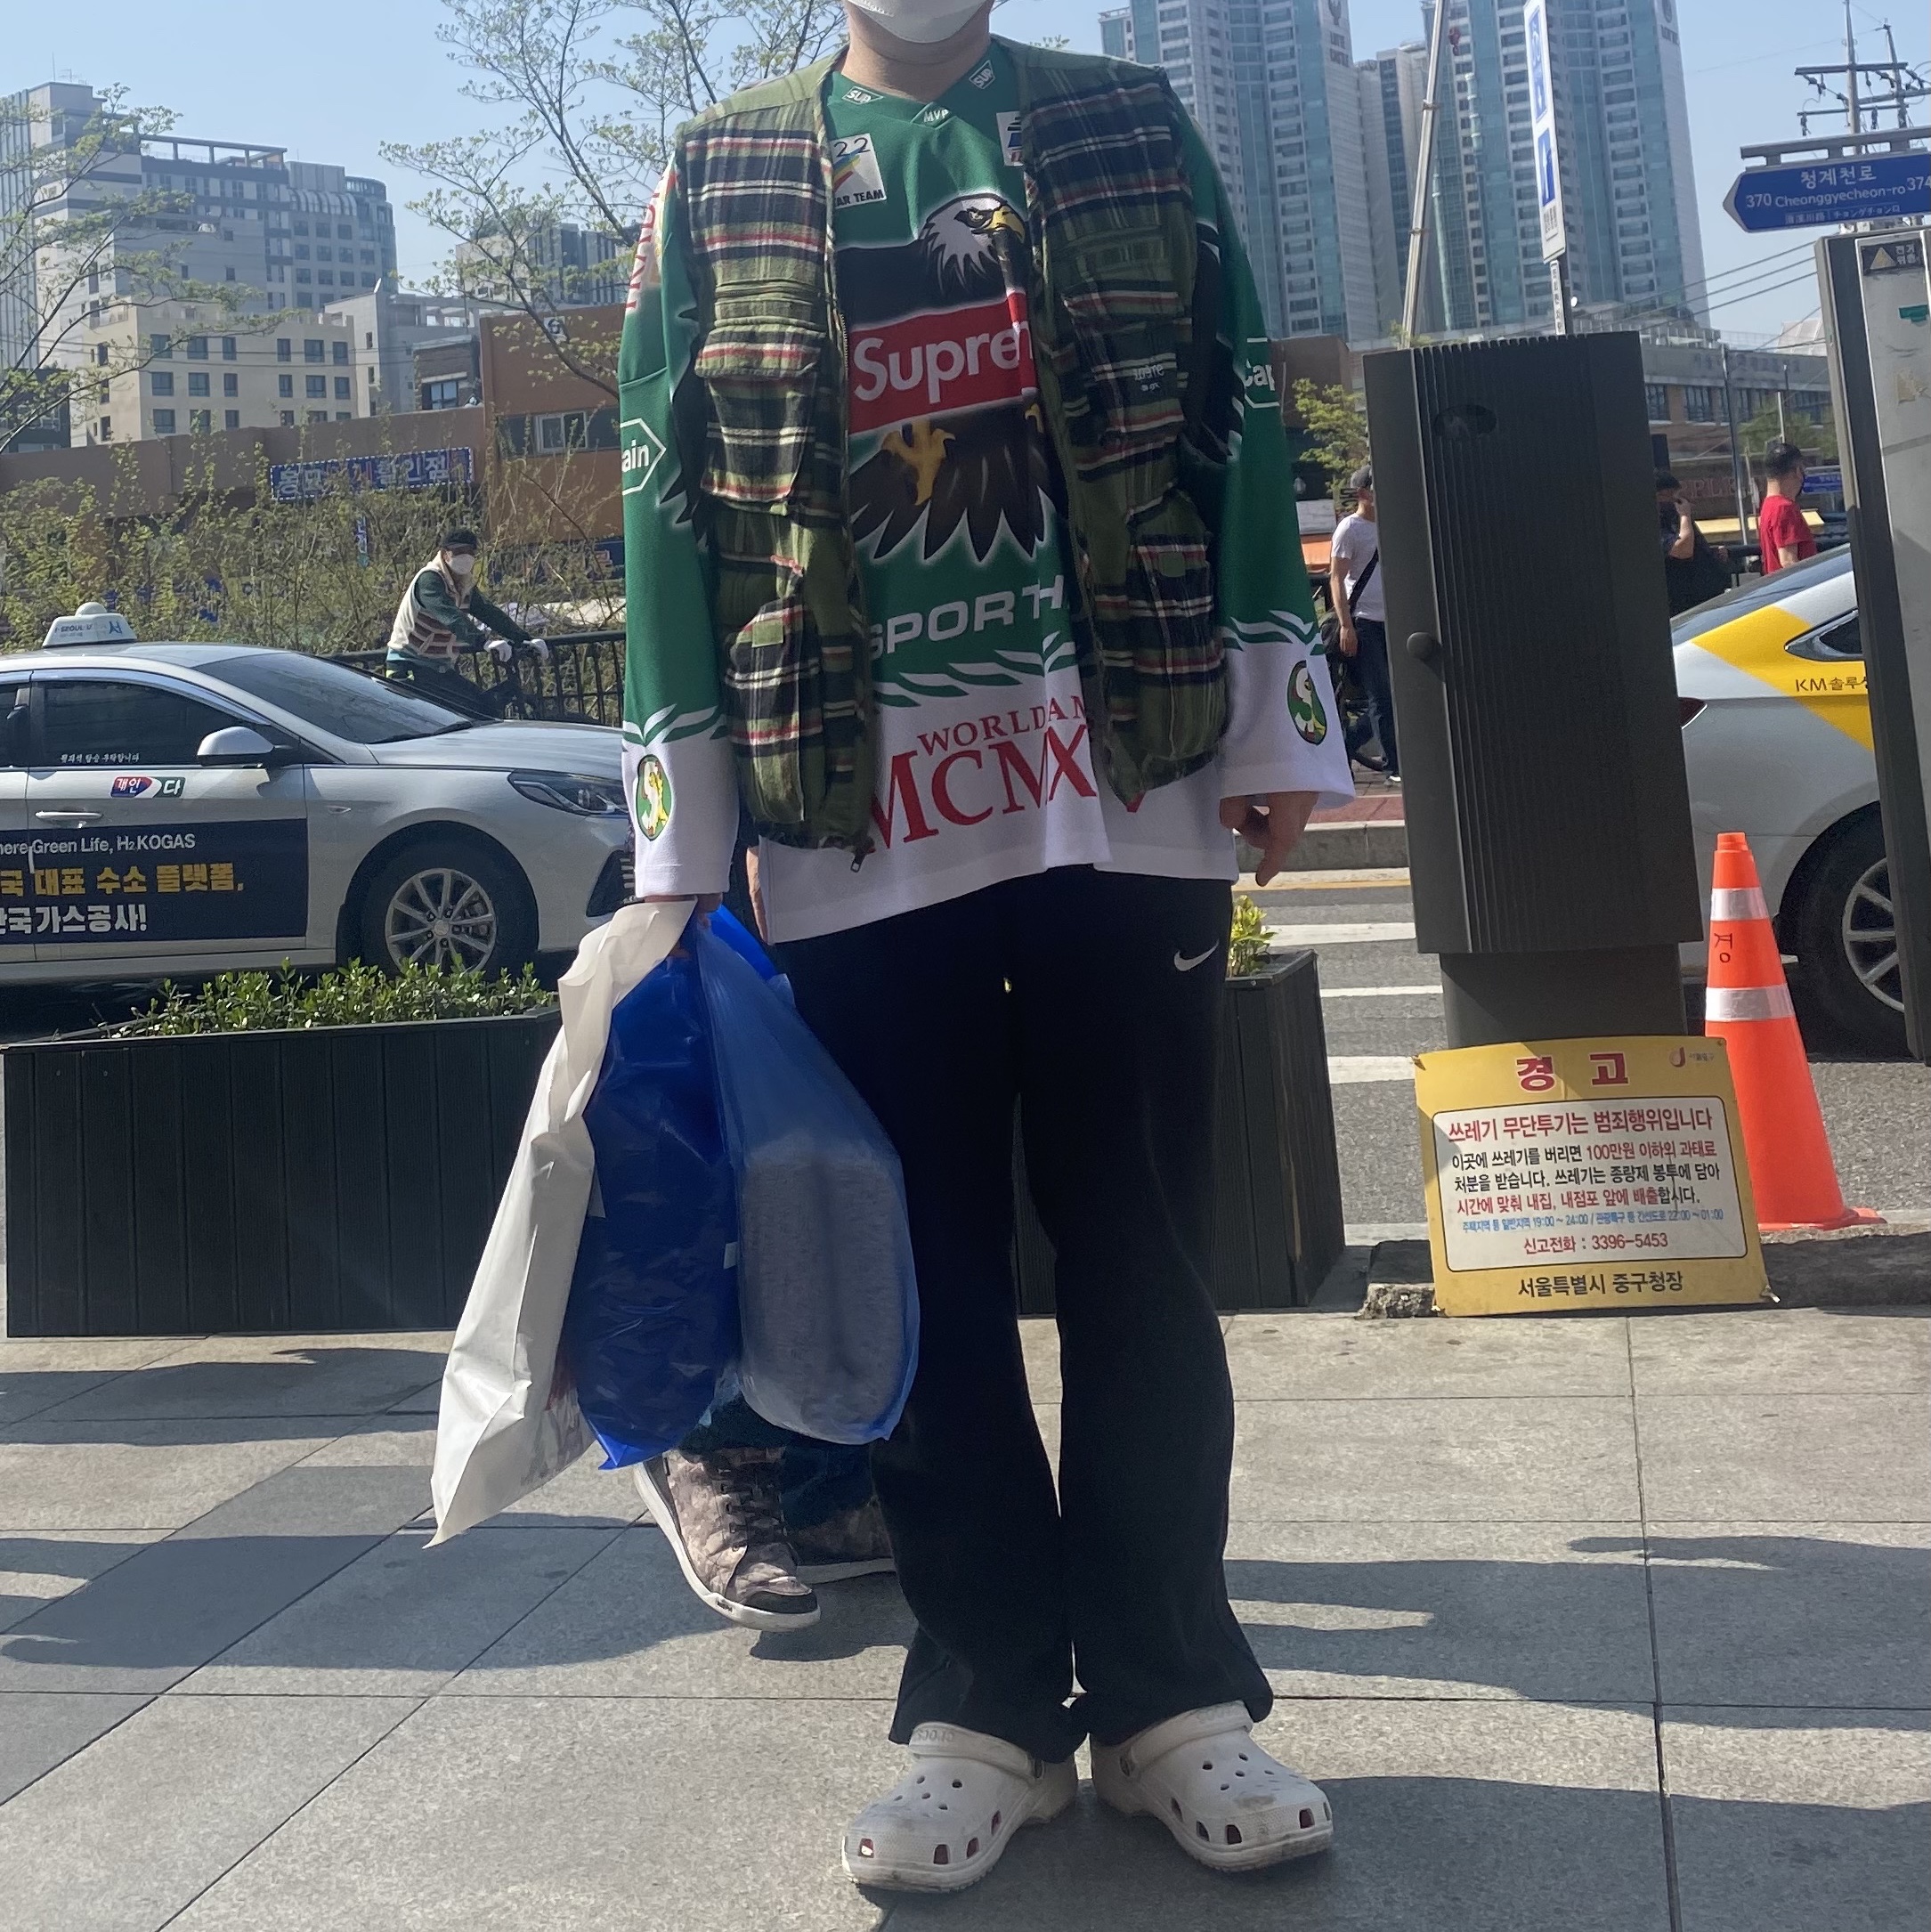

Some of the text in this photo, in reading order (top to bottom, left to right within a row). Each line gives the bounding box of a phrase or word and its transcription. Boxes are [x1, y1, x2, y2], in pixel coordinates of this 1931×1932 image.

[923, 108, 950, 123] MVP
[1800, 165, 1877, 190] 청계천로
[853, 189, 884, 202] TEAM
[1745, 193, 1773, 208] 370
[1774, 185, 1906, 208] Cheonggyecheon-ro
[117, 778, 142, 794] 개인
[163, 780, 181, 795] 다
[32, 839, 77, 854] Green
[81, 838, 114, 855] Life,
[35, 867, 86, 896] 대표
[97, 866, 147, 895] 수소
[156, 862, 244, 892] 플랫폼,
[1448, 1108, 1712, 1142] 쓰레기 무단투기는 범죄행위입니다
[1452, 1141, 1717, 1170] 이곳에 쓰레기를 버리면 100만원 이하의 과태료
[1455, 1163, 1720, 1193] 처분을 받습니다. 쓰레기는 종량제 봉투에 담아
[1456, 1186, 1701, 1215] 시간에 맞춰 내집, 내점포 앞에 배출합시다.
[1533, 1216, 1554, 1228] 19:00
[1566, 1214, 1588, 1226] 24:00
[1700, 1208, 1724, 1221] 01:00
[1523, 1235, 1577, 1254] 신고전화
[1592, 1232, 1668, 1250] 3396-5453
[1518, 1270, 1684, 1298] 서울특별시 중구청장
